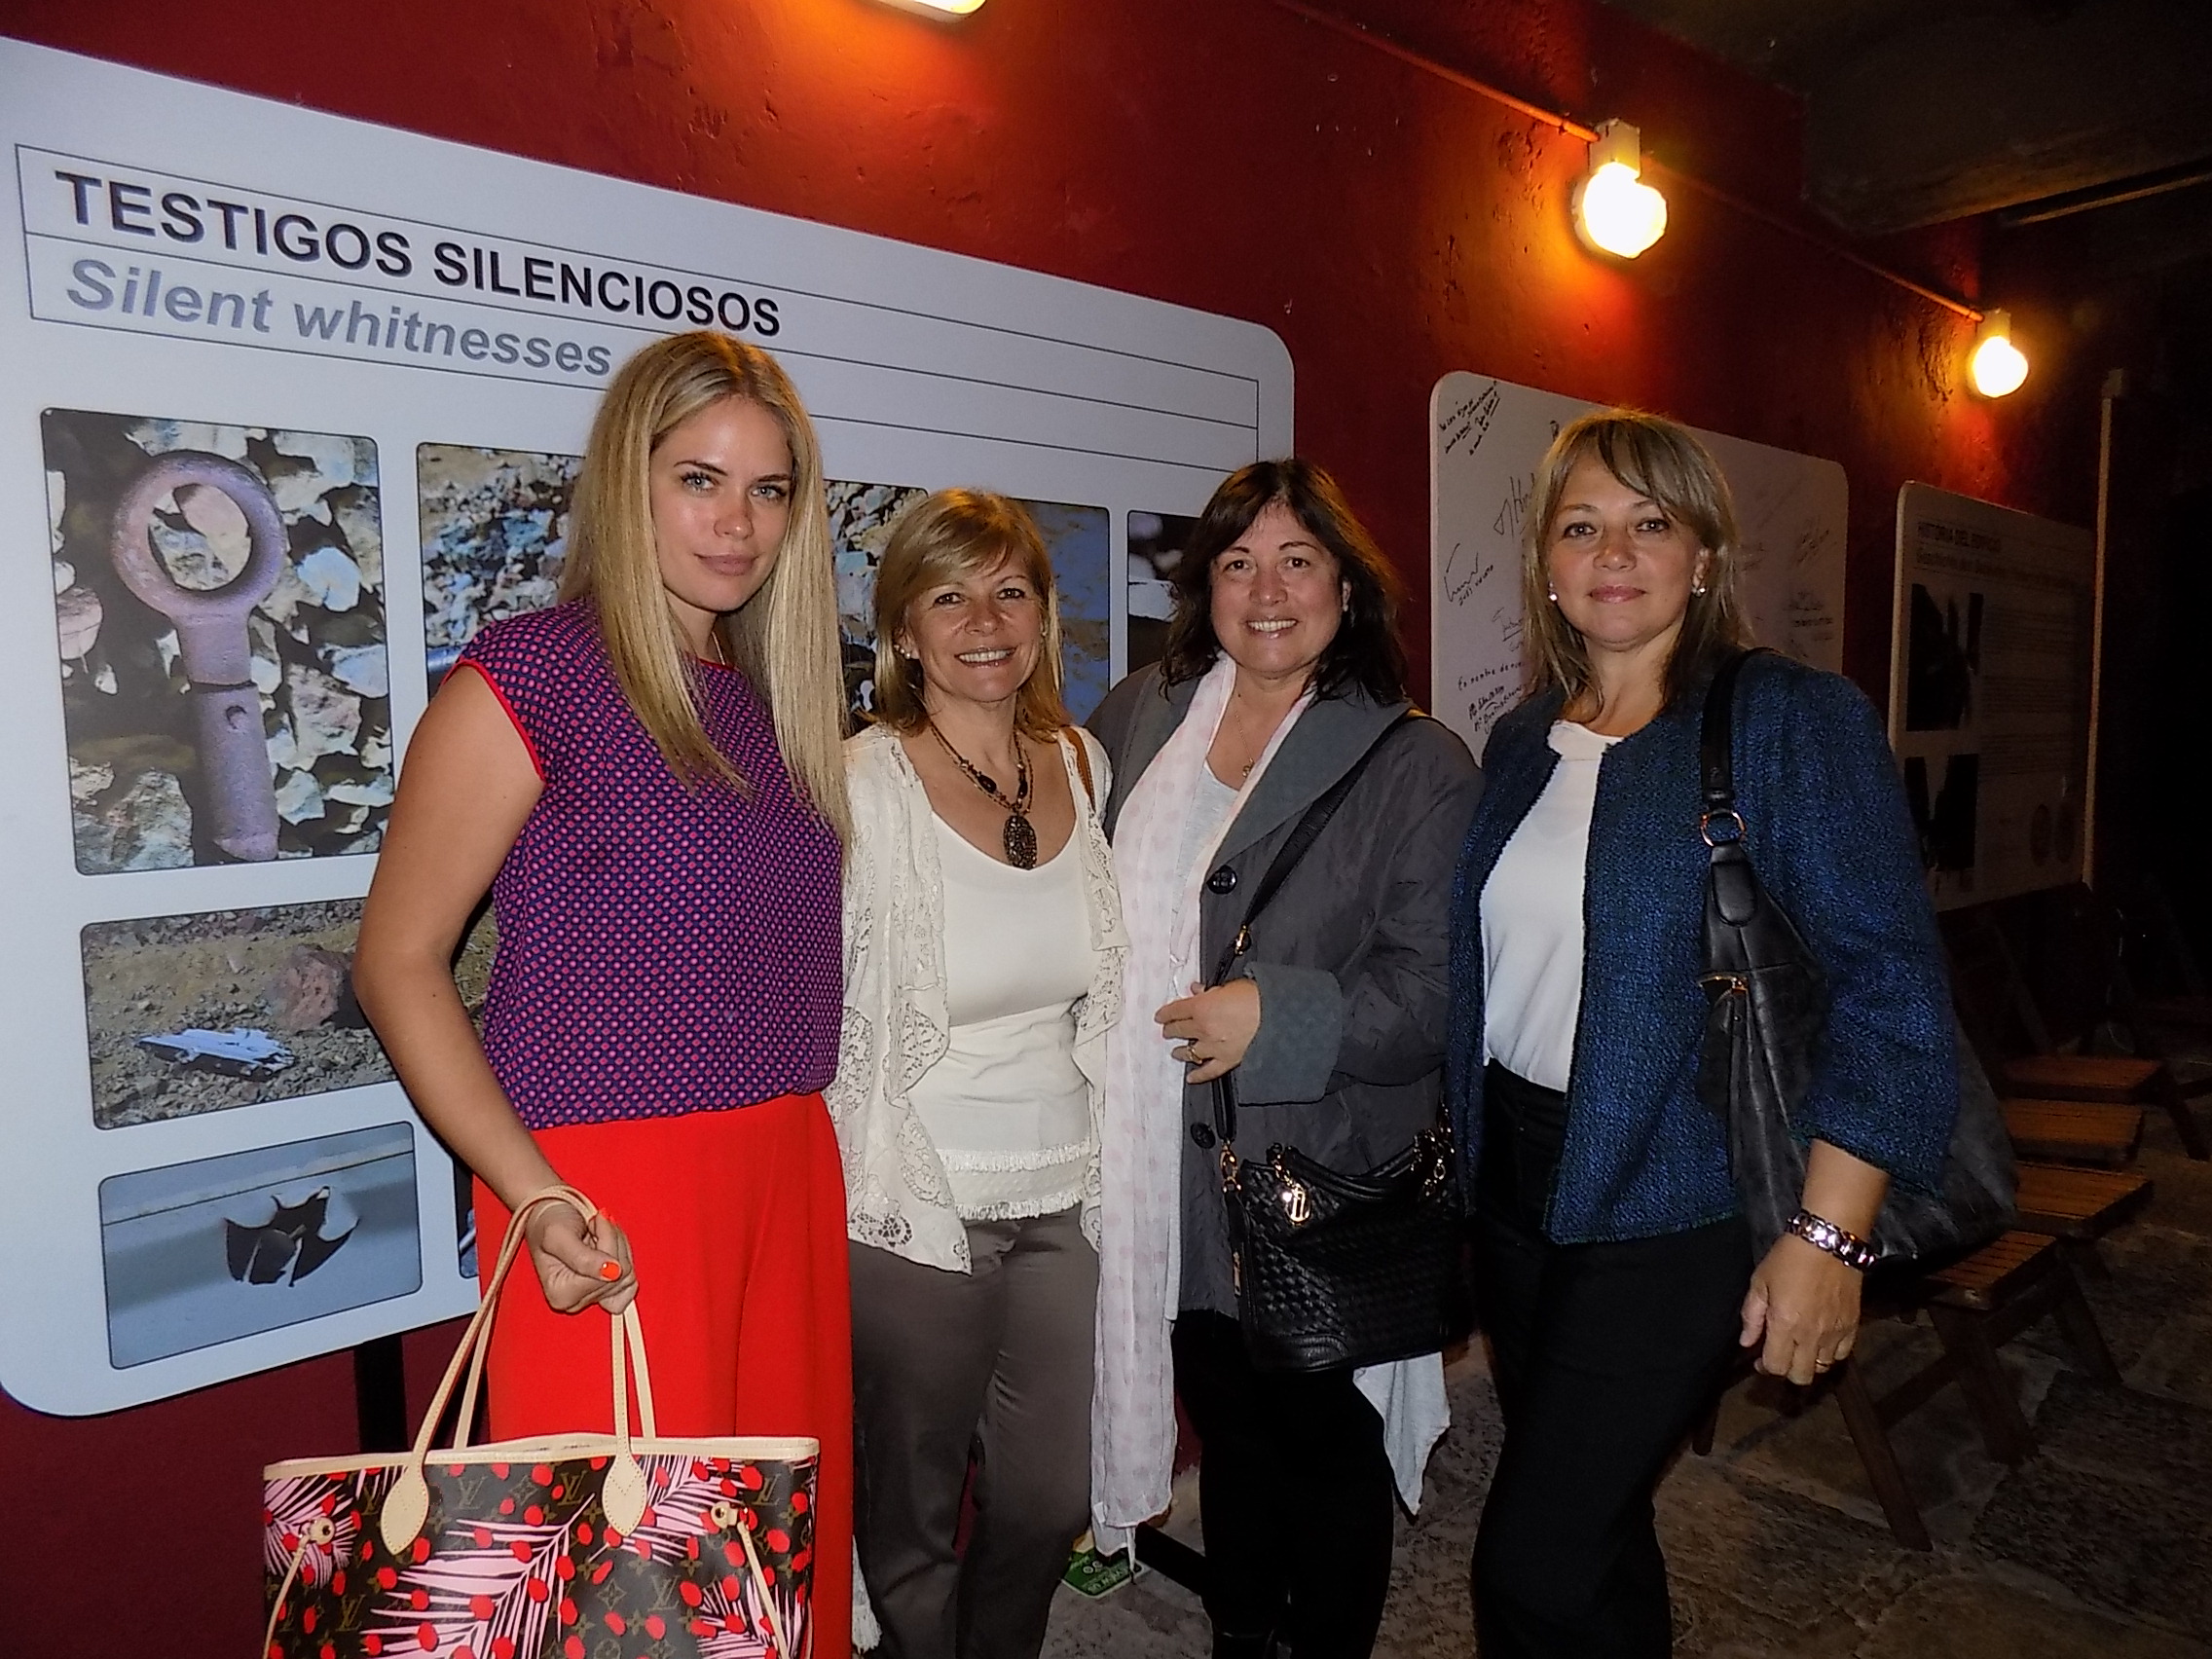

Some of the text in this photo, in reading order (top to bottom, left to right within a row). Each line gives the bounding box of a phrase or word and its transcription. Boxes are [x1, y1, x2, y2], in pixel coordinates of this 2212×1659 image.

[55, 170, 781, 337] TESTIGOS SILENCIOSOS
[66, 258, 612, 377] Silent whitnesses
